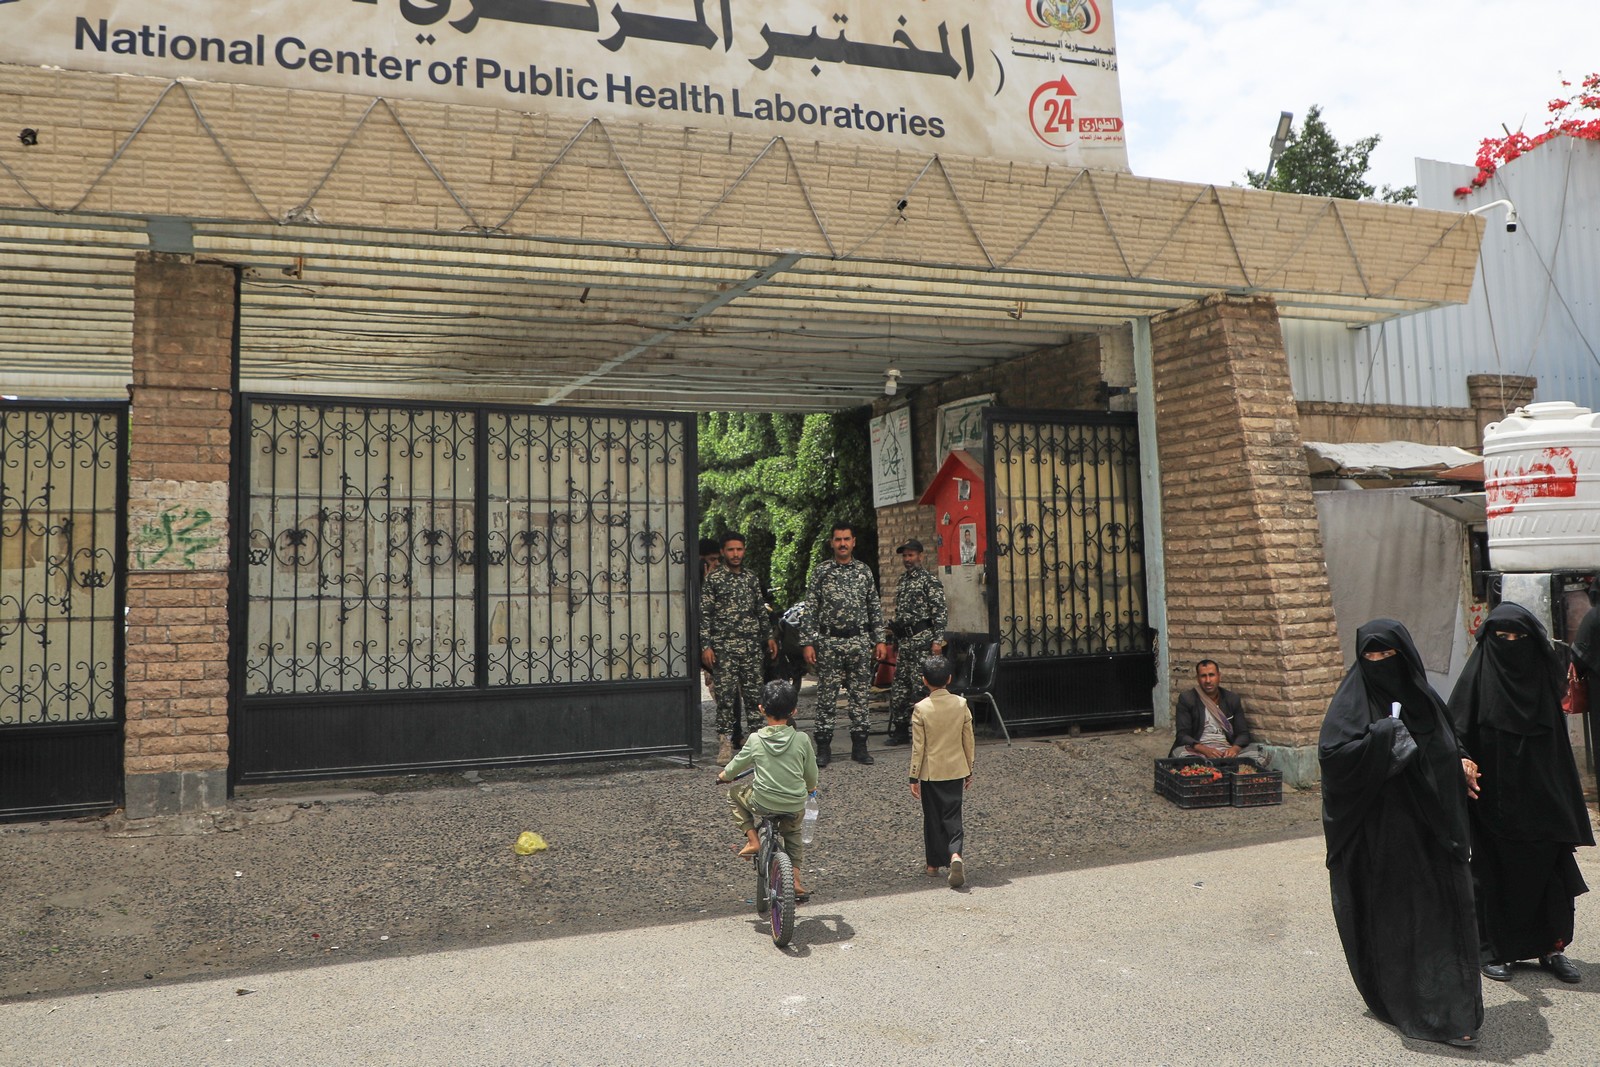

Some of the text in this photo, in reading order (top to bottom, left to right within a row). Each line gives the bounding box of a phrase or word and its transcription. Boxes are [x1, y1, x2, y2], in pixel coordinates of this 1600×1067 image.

[1010, 33, 1116, 57] الجمهورية اليمنية
[1059, 52, 1100, 67] الصحة
[1101, 58, 1118, 72] وزارة
[75, 17, 946, 139] National Center of Public Health Laboratories
[1044, 98, 1074, 133] 24
[1081, 118, 1118, 132] الطوارئ
